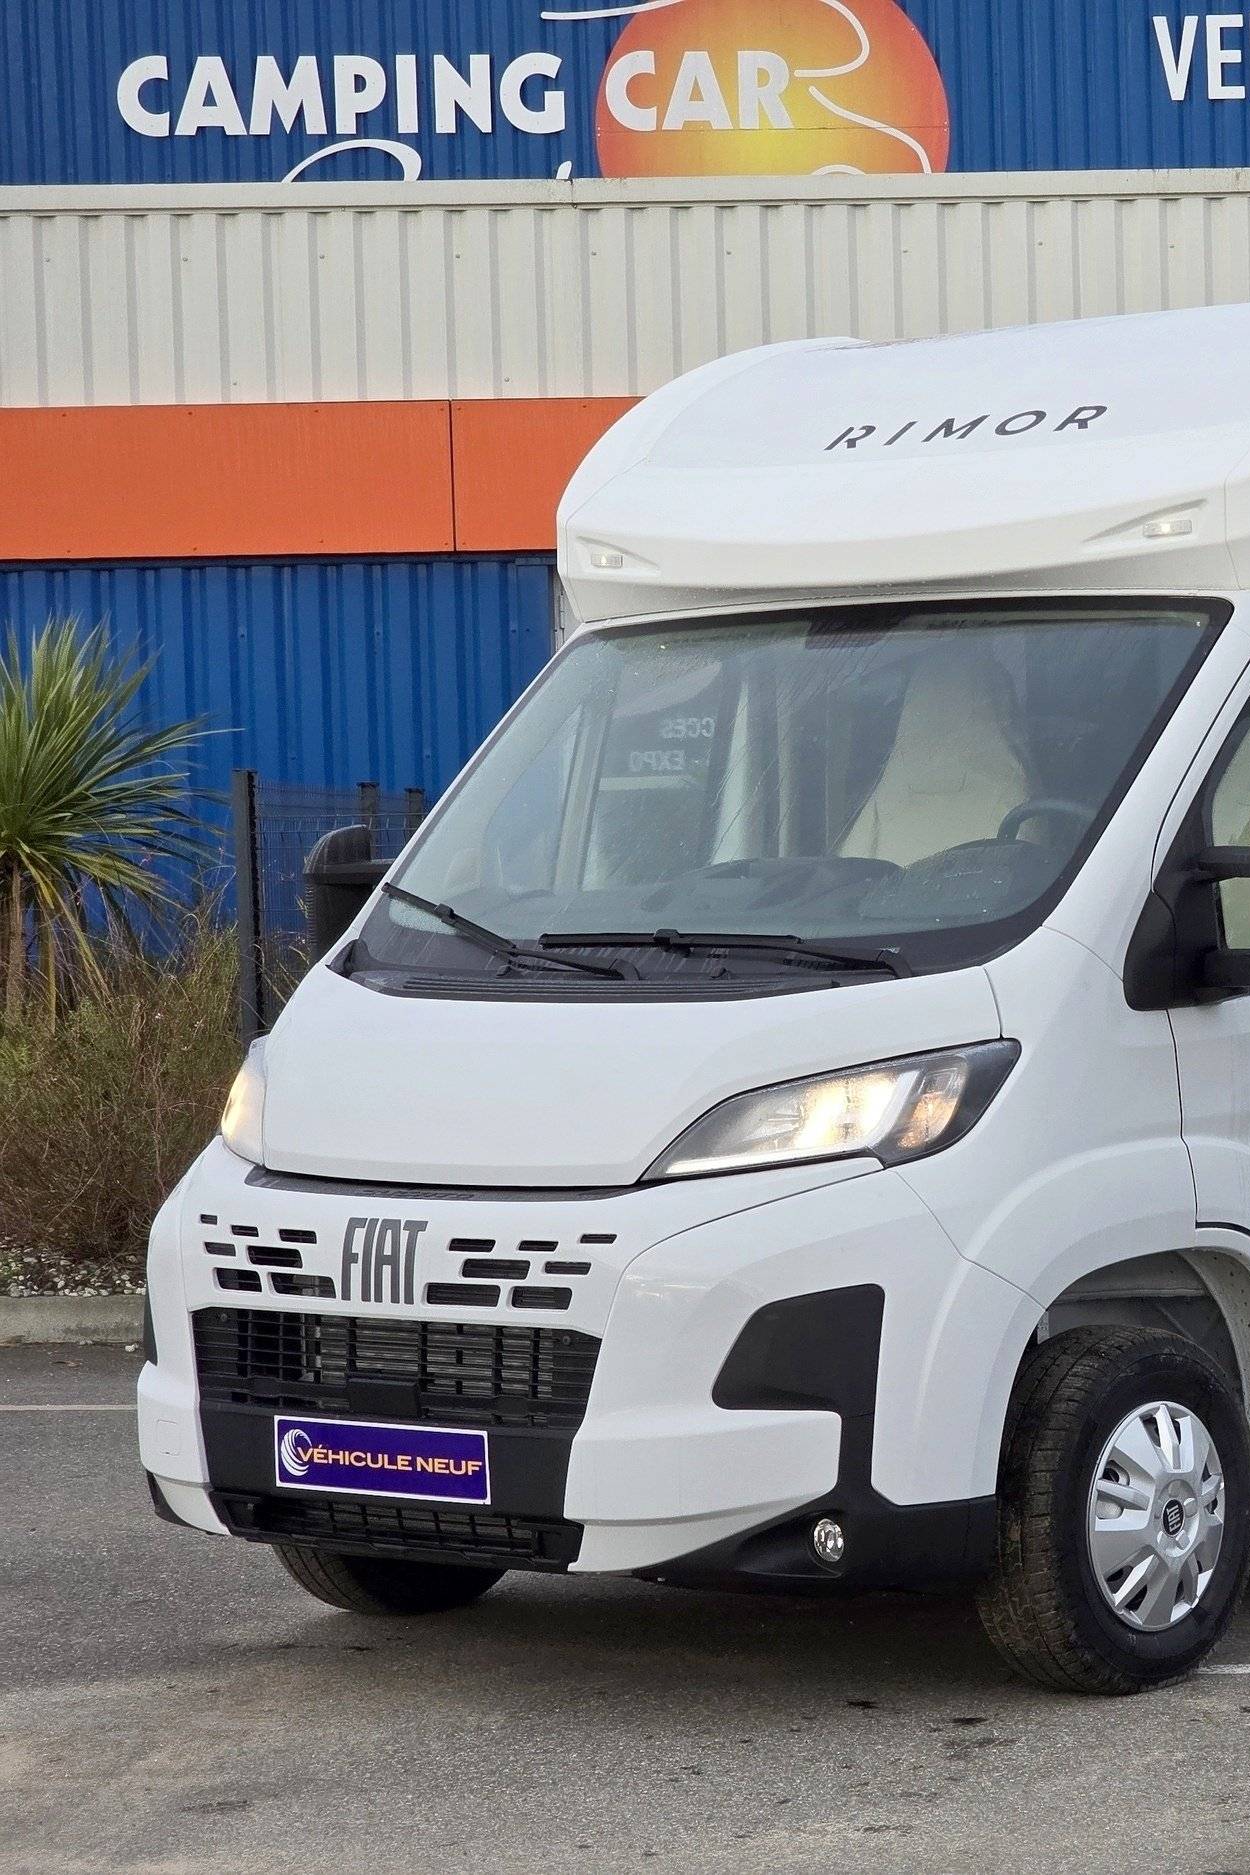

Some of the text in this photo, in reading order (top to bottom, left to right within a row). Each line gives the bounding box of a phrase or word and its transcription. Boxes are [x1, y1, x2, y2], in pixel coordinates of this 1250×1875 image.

[117, 51, 793, 136] CAMPING CAR
[823, 404, 1108, 451] RIMOR
[341, 1216, 429, 1305] FIAT
[297, 1445, 483, 1476] VÉHICULE NEUF
[1166, 1504, 1182, 1533] FIAT
